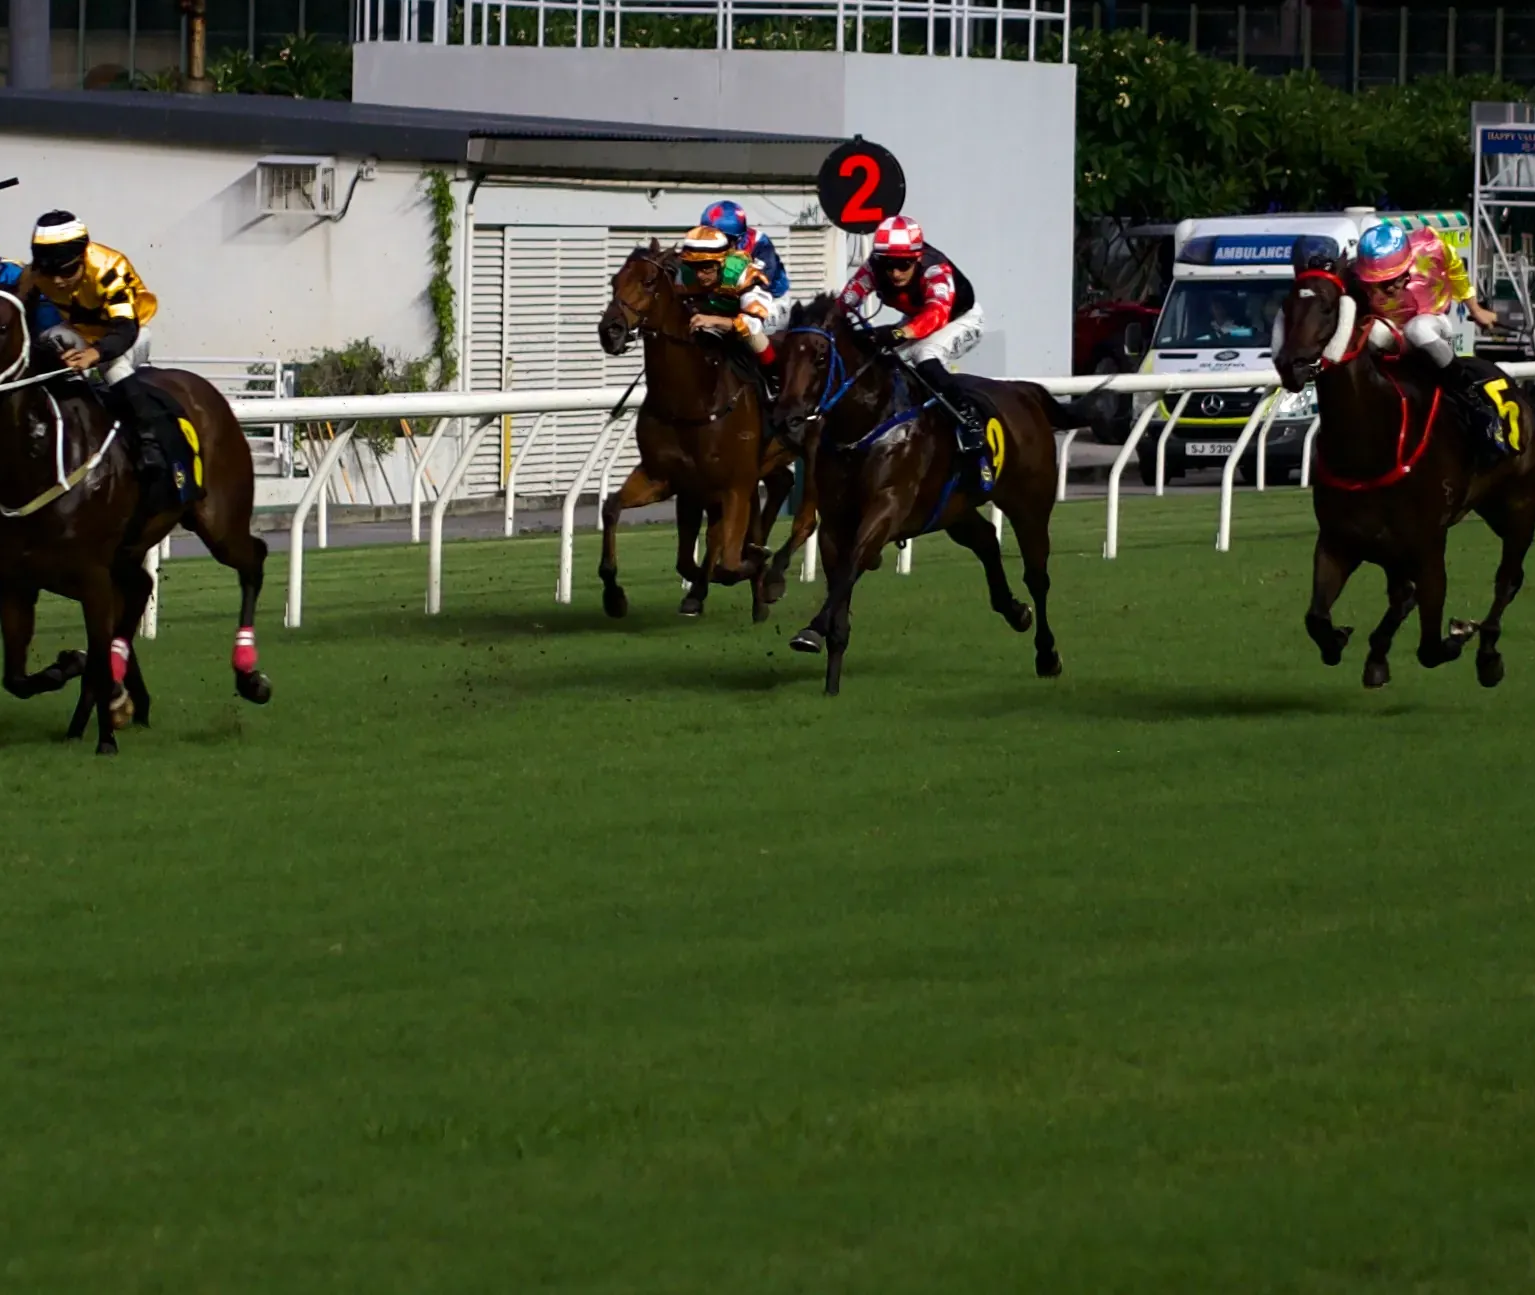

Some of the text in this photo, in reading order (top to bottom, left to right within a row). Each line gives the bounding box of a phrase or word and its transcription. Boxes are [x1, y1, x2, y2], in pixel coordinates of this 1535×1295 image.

[839, 154, 882, 223] 2
[1214, 245, 1293, 261] AMBULANCE
[1483, 376, 1521, 452] 5
[985, 416, 1006, 485] 9
